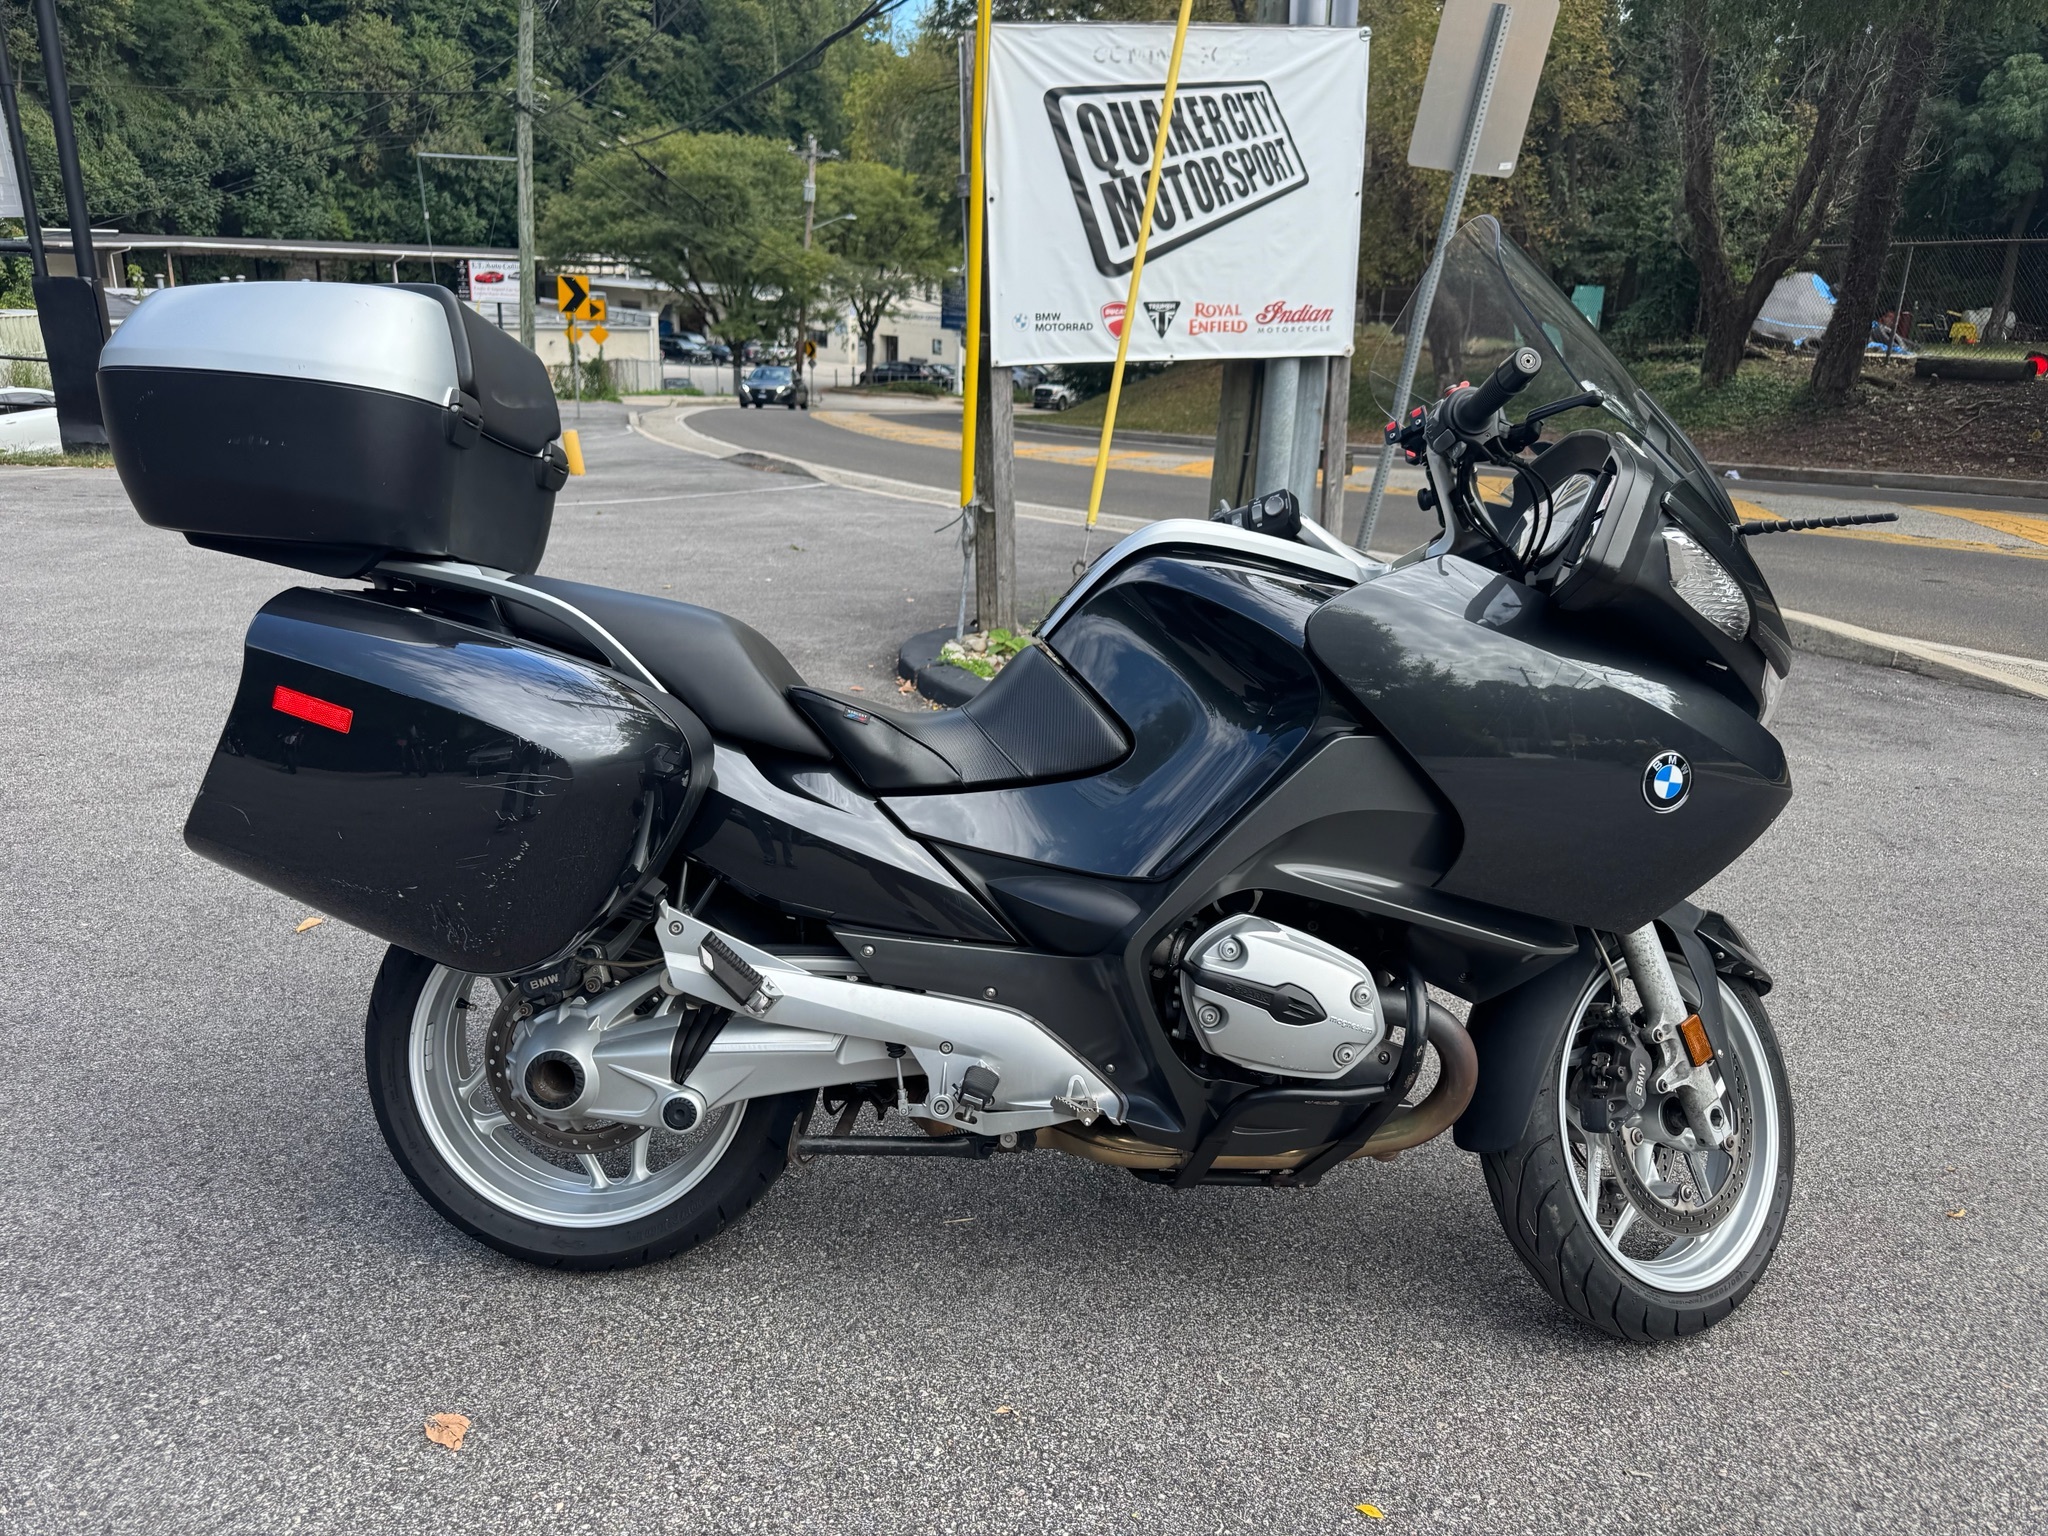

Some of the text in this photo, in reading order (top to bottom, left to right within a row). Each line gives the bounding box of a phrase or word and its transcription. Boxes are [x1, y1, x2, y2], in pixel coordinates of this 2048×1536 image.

[1076, 91, 1278, 178] QUAKER CITY
[1099, 137, 1296, 250] MOTORSPORT
[1035, 312, 1061, 321] BMW
[1105, 307, 1126, 316] DUCA
[1195, 302, 1242, 318] ROYAL
[1255, 300, 1334, 325] Indian
[1035, 322, 1093, 332] MOTORRAD
[1189, 319, 1248, 336] ENFIELD
[1257, 325, 1330, 334] MOTORCYCLE
[1652, 755, 1689, 775] BMW
[529, 973, 560, 990] BMW
[1329, 1015, 1372, 1034] magnesium
[1634, 1063, 1647, 1096] BMW
